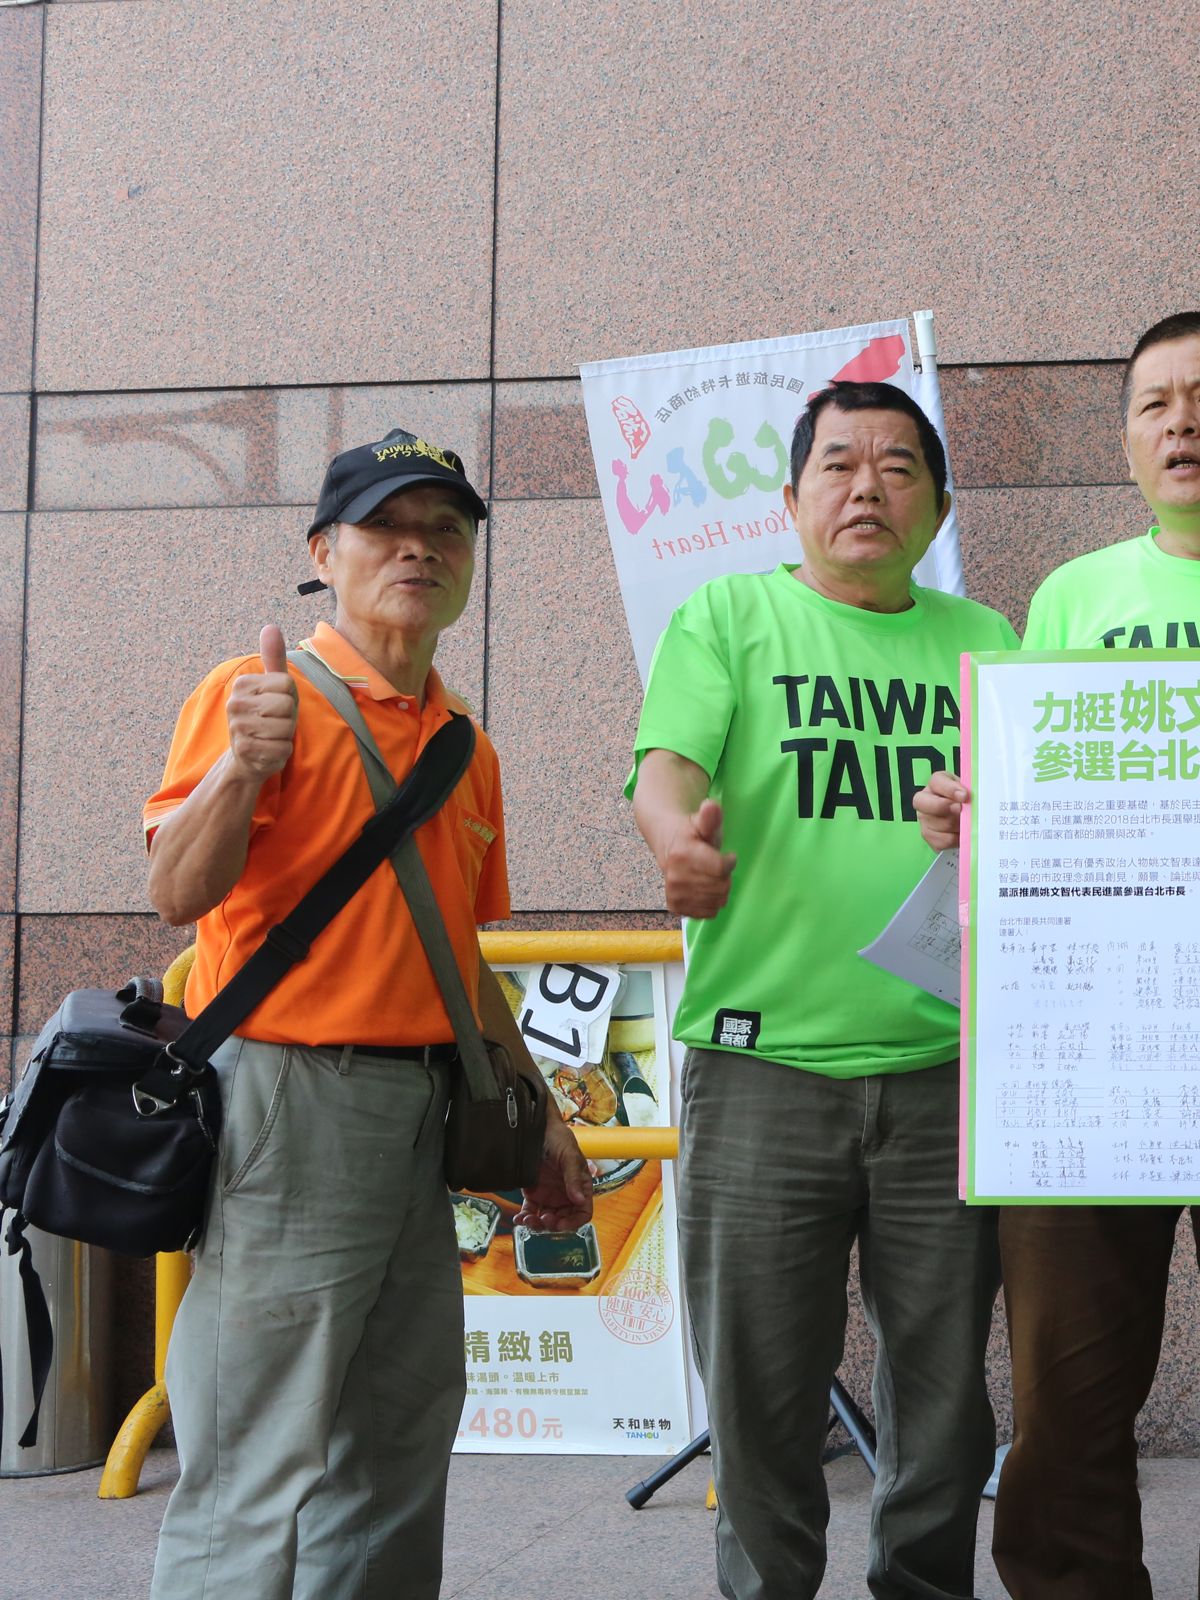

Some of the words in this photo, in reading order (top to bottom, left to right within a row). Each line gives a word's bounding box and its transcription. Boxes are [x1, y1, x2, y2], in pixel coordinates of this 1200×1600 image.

[772, 674, 961, 735] TAIWA
[780, 737, 961, 822] TAIP
[722, 1016, 752, 1034] 國家
[719, 1032, 749, 1048] 首都
[464, 1330, 574, 1363] 精緻鍋
[612, 1417, 672, 1430] 天和鮮物
[625, 1431, 660, 1440] TANHOU
